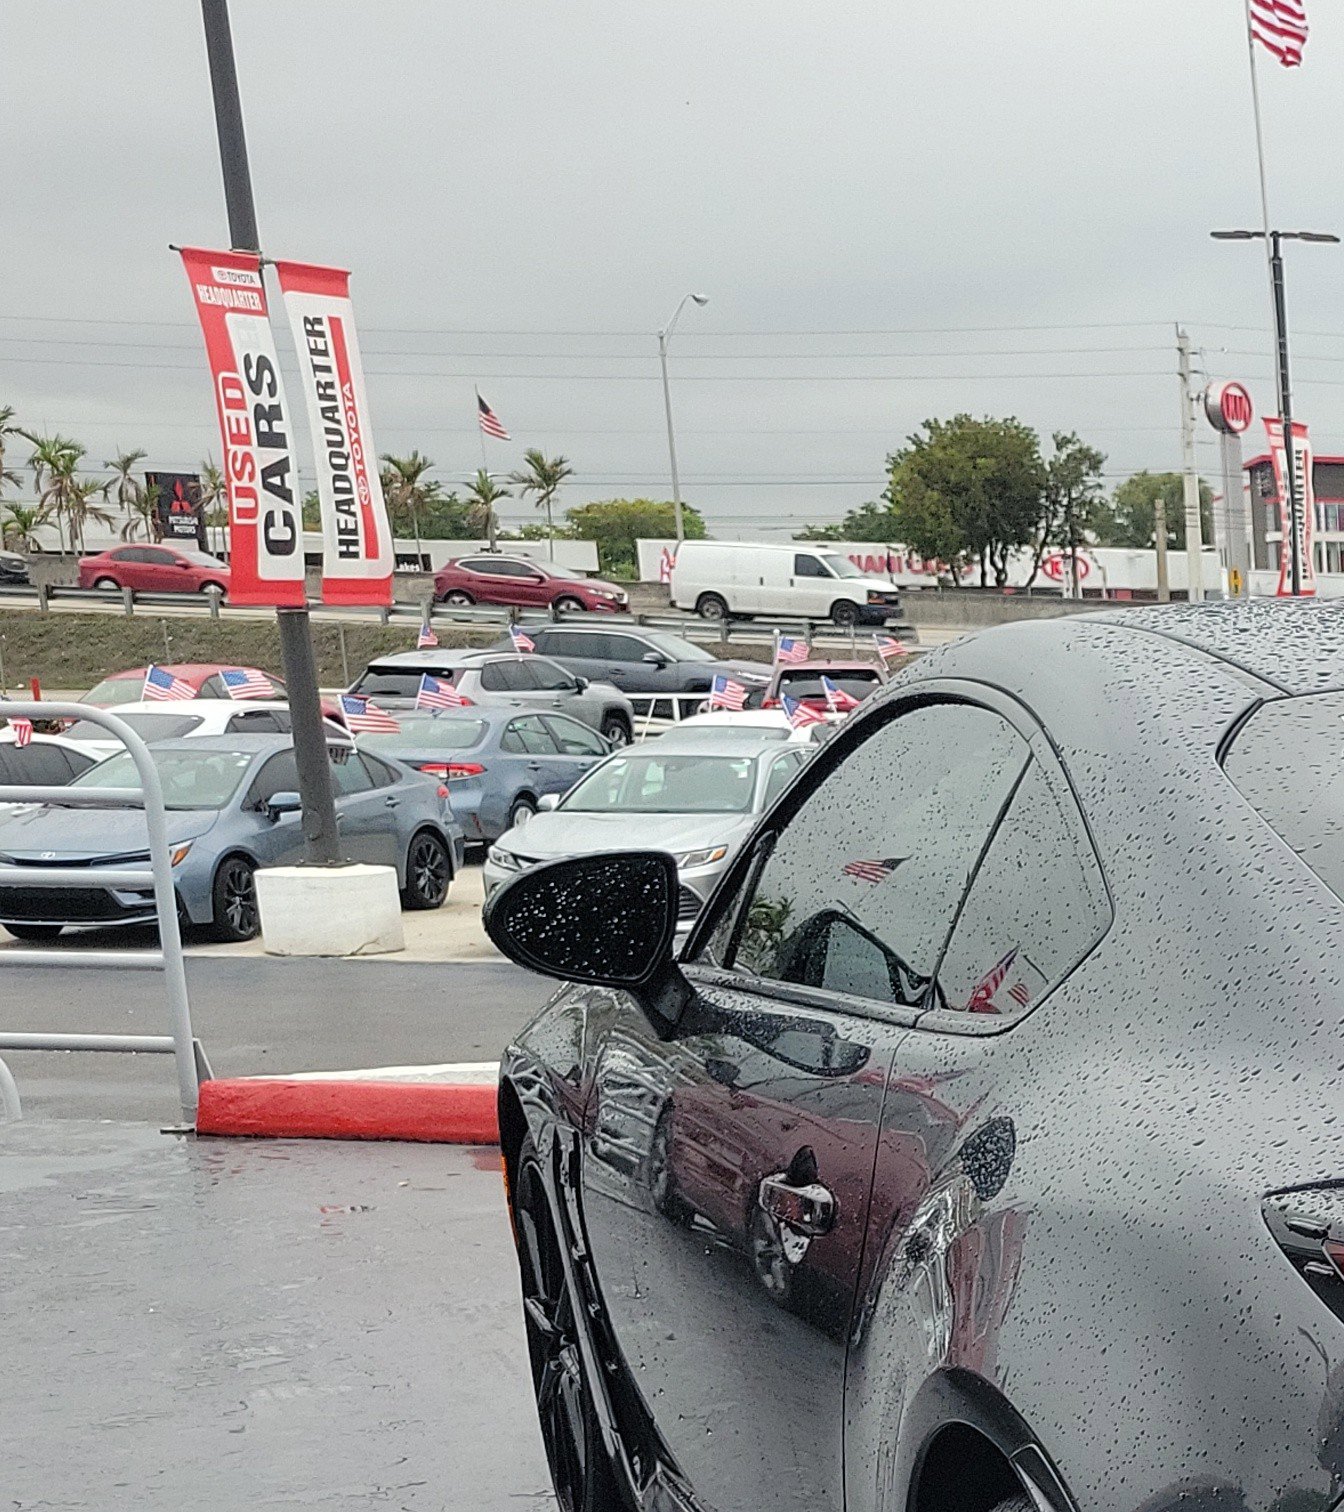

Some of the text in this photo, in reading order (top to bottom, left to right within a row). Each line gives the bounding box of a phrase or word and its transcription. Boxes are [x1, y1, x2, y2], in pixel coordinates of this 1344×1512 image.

[196, 283, 263, 311] HEADQUARTER
[218, 372, 260, 525] USED
[244, 352, 297, 556] CARS
[303, 315, 360, 559] HEADQUARTER
[342, 381, 370, 477] TOYOTA
